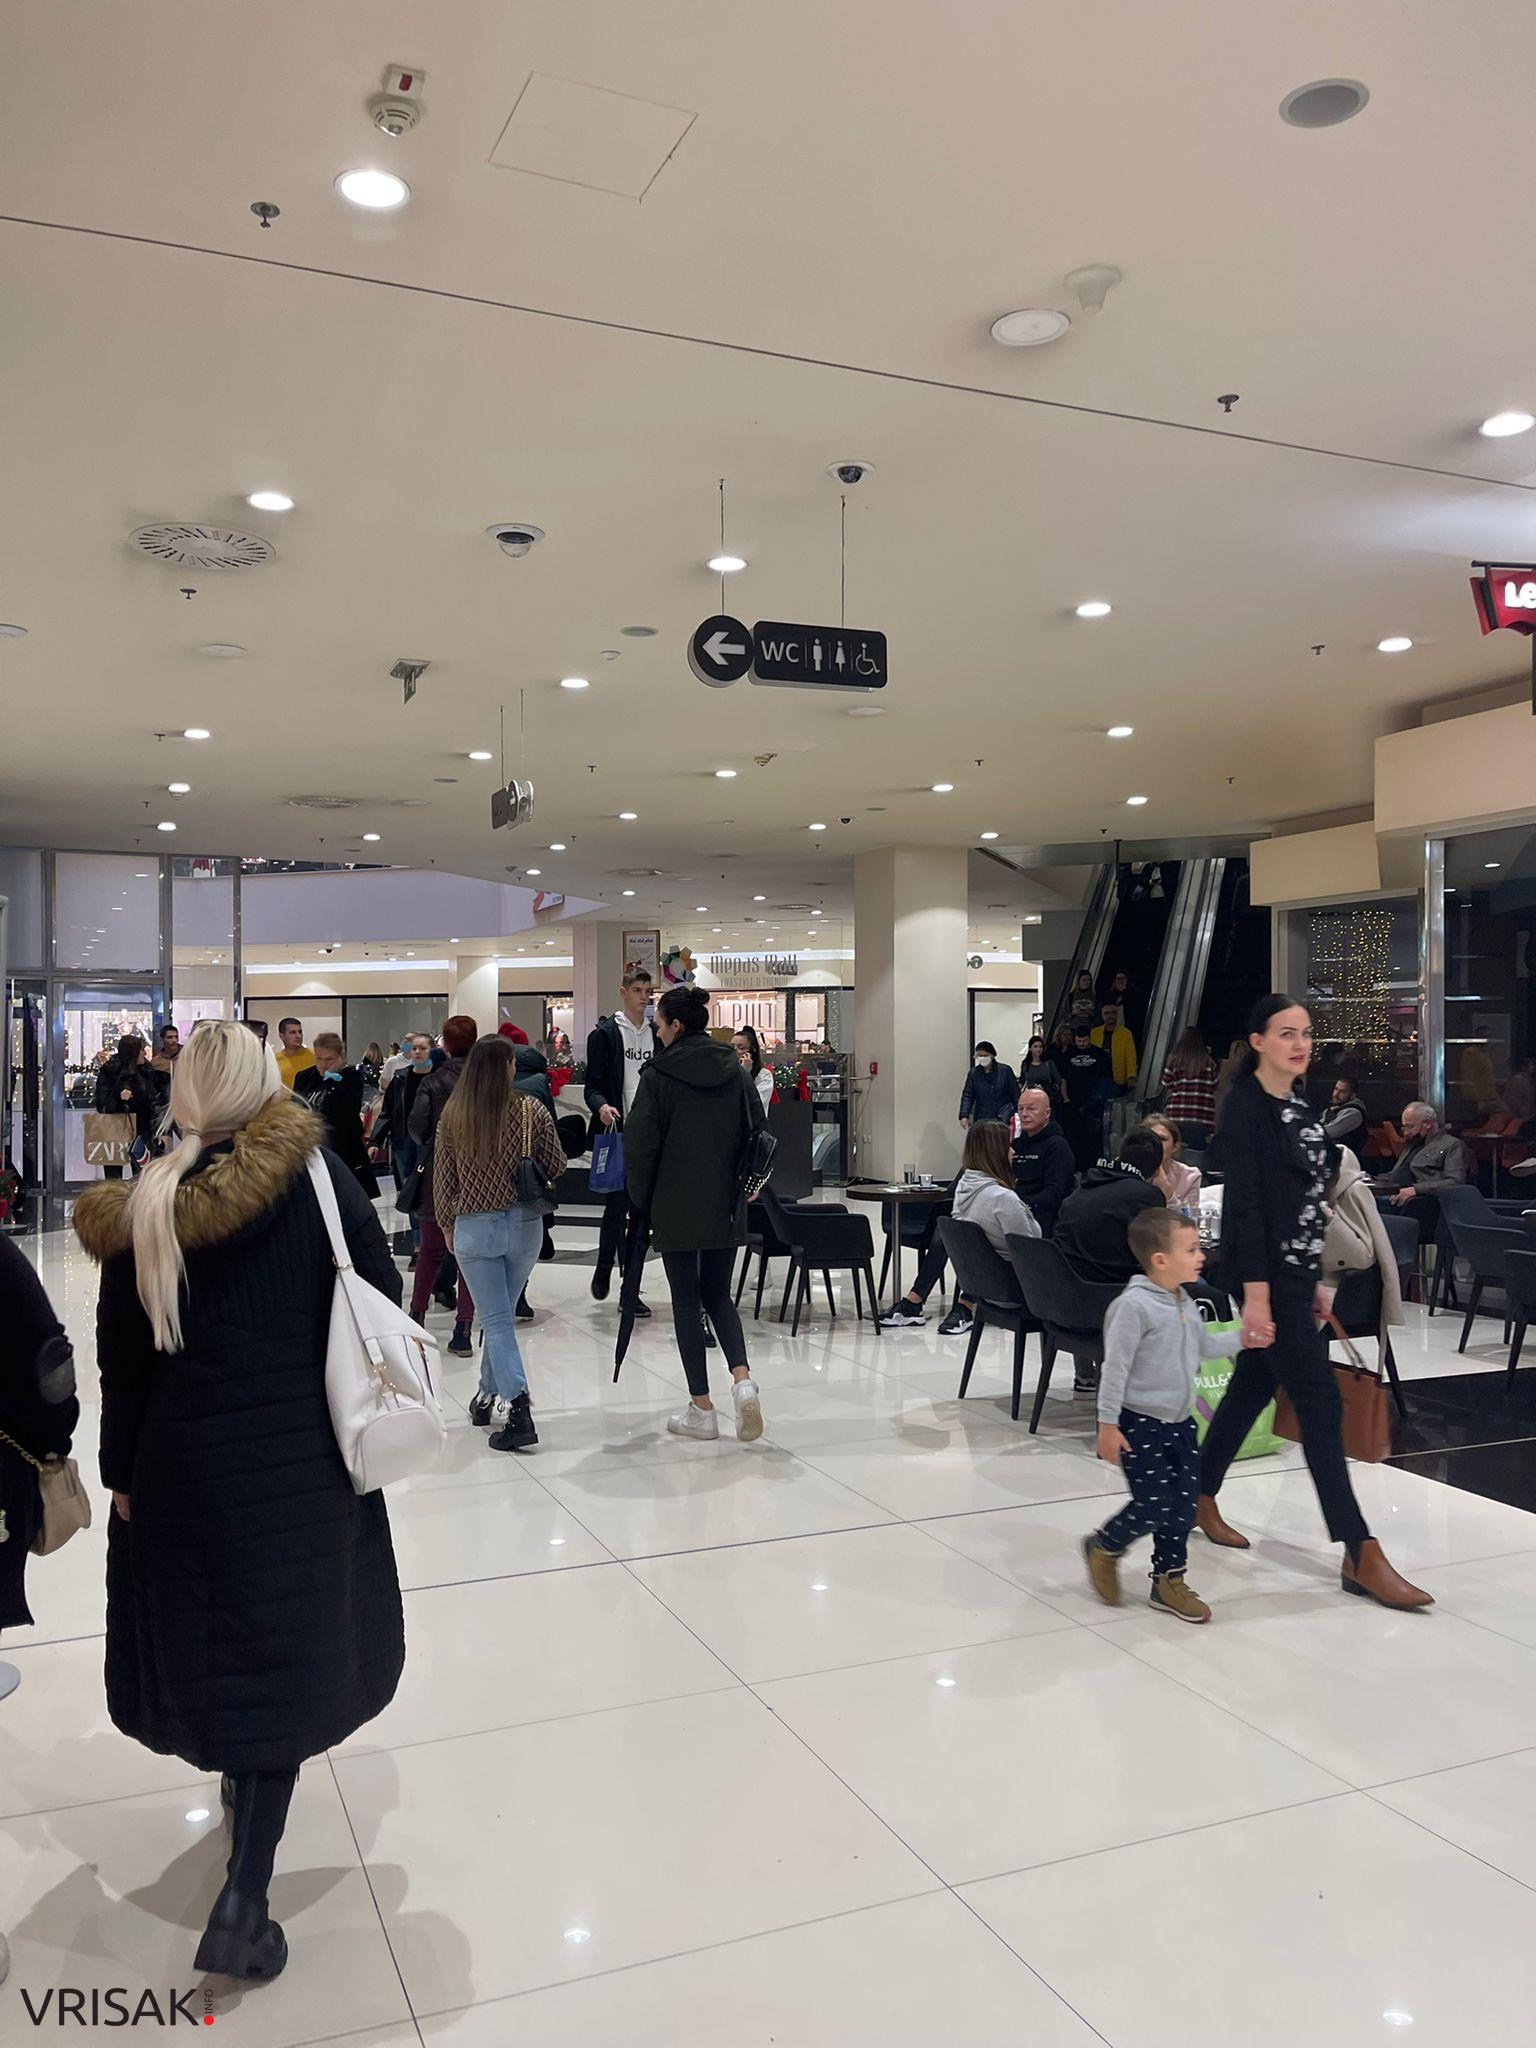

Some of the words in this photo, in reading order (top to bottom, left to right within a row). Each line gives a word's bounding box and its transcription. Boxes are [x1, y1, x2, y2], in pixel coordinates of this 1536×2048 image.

[761, 640, 799, 663] WC
[711, 955, 760, 976] Mepas
[733, 1003, 771, 1028] PULT
[625, 1047, 652, 1061] dida
